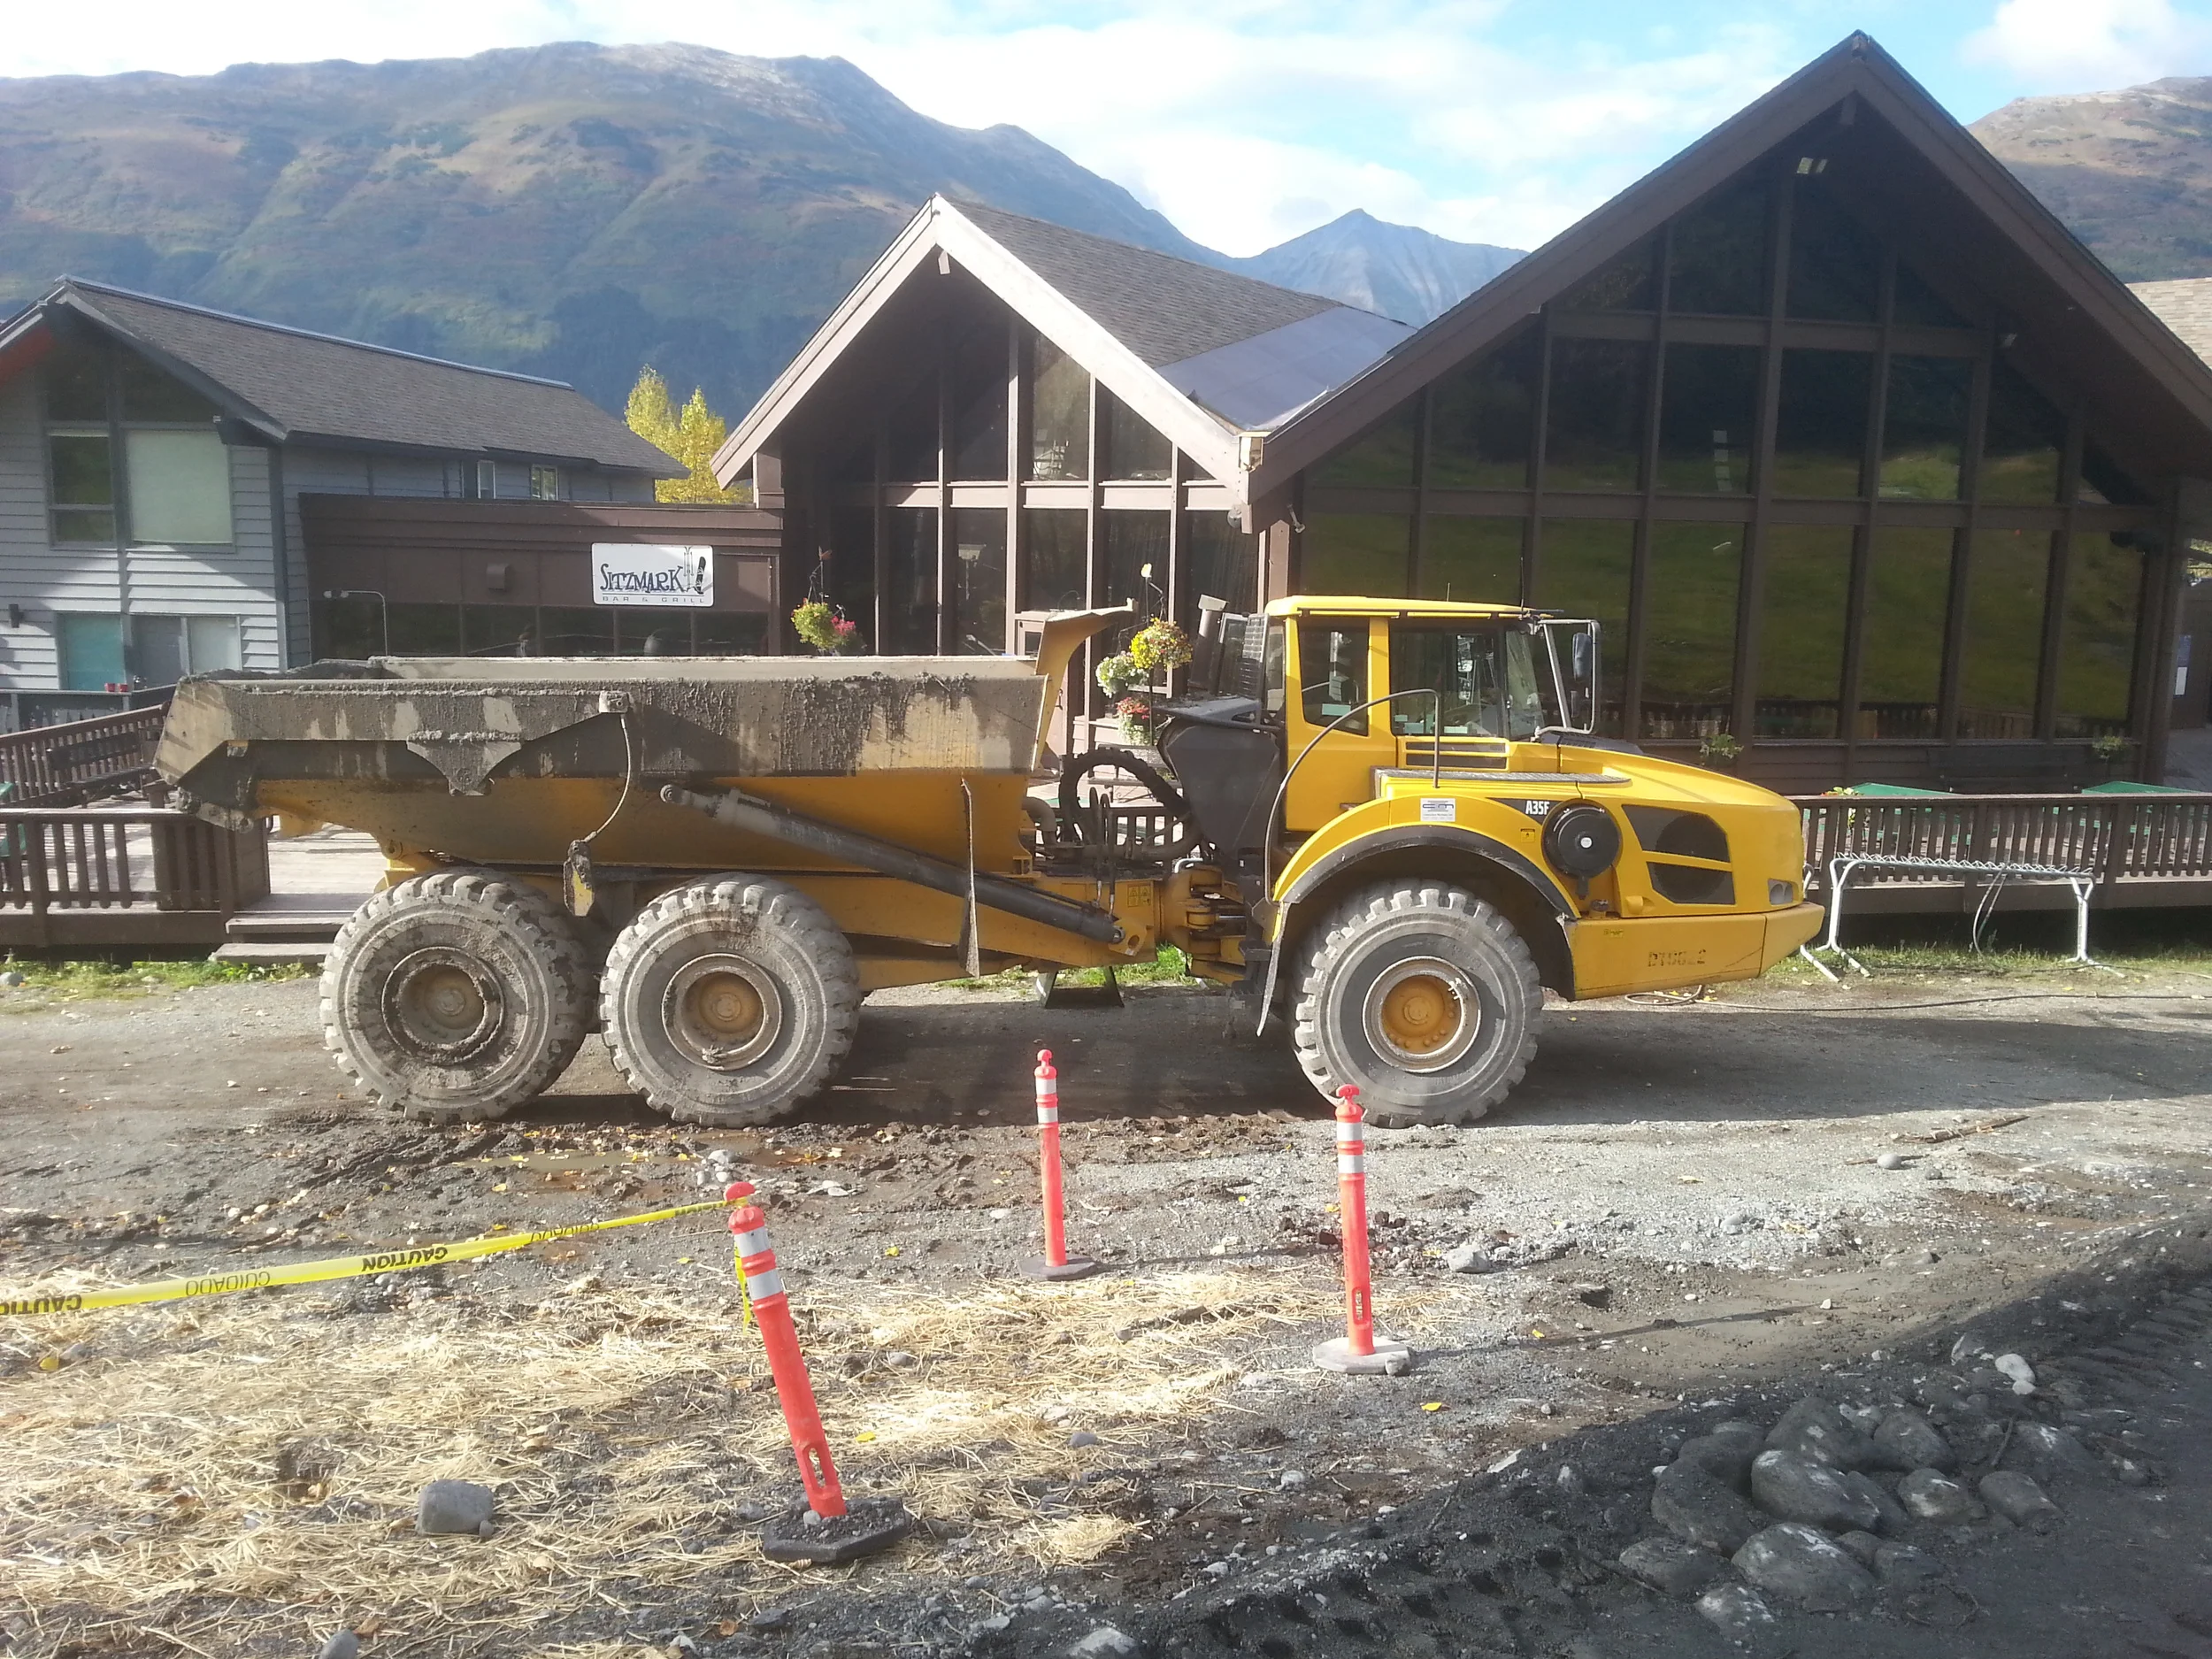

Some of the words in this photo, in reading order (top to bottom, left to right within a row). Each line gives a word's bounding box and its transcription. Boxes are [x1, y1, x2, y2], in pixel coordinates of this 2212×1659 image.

[600, 563, 685, 594] SITZMARK
[1525, 800, 1550, 815] A35F
[361, 1247, 449, 1272] CAUTION
[185, 1271, 271, 1297] CUIDADO
